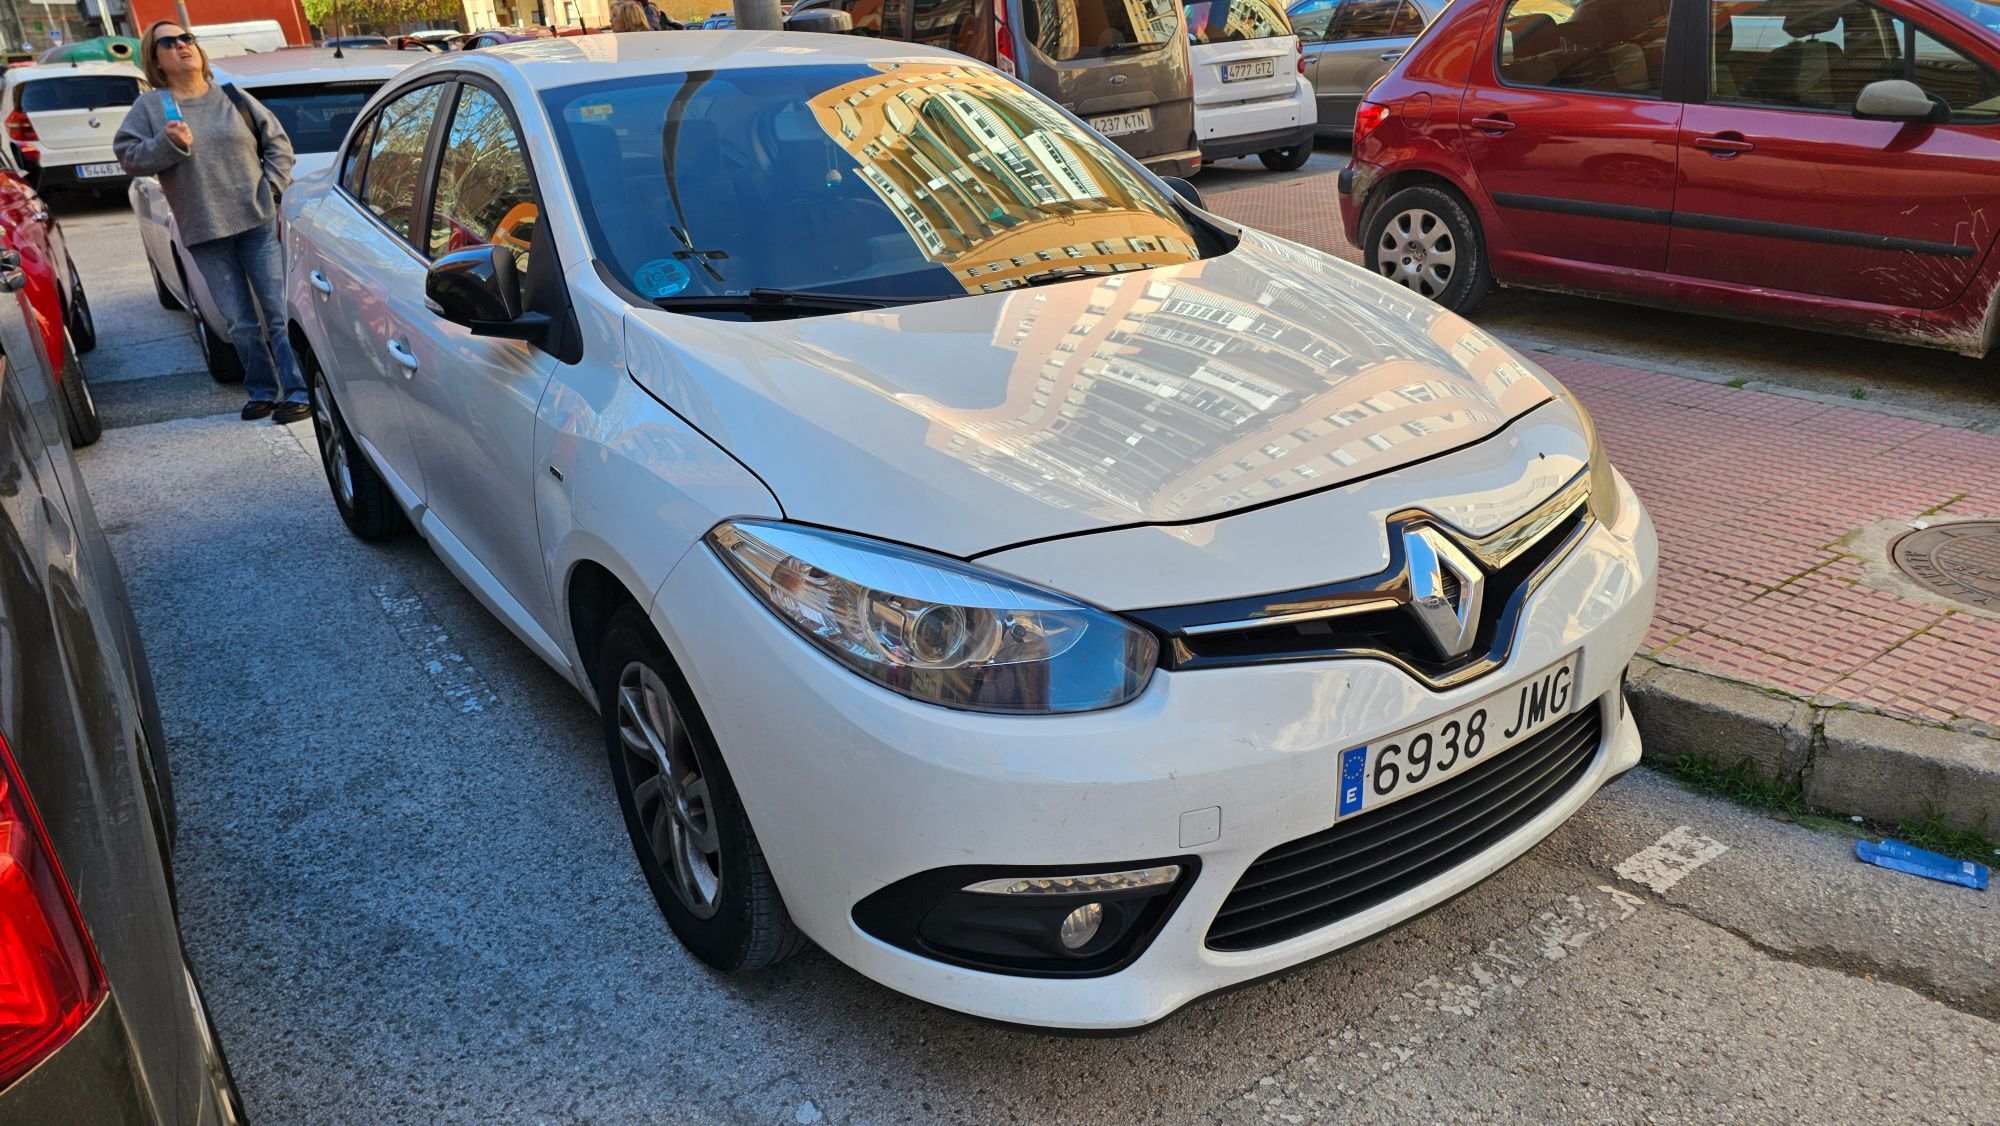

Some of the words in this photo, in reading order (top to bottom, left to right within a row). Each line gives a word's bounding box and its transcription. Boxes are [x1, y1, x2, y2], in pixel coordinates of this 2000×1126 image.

[1229, 64, 1252, 78] 4777
[1255, 62, 1272, 75] GTZ
[1094, 117, 1120, 133] 4237
[1123, 114, 1146, 129] KTN
[1346, 787, 1358, 804] E
[1373, 708, 1488, 796] 6938
[1504, 665, 1572, 739] JMG
